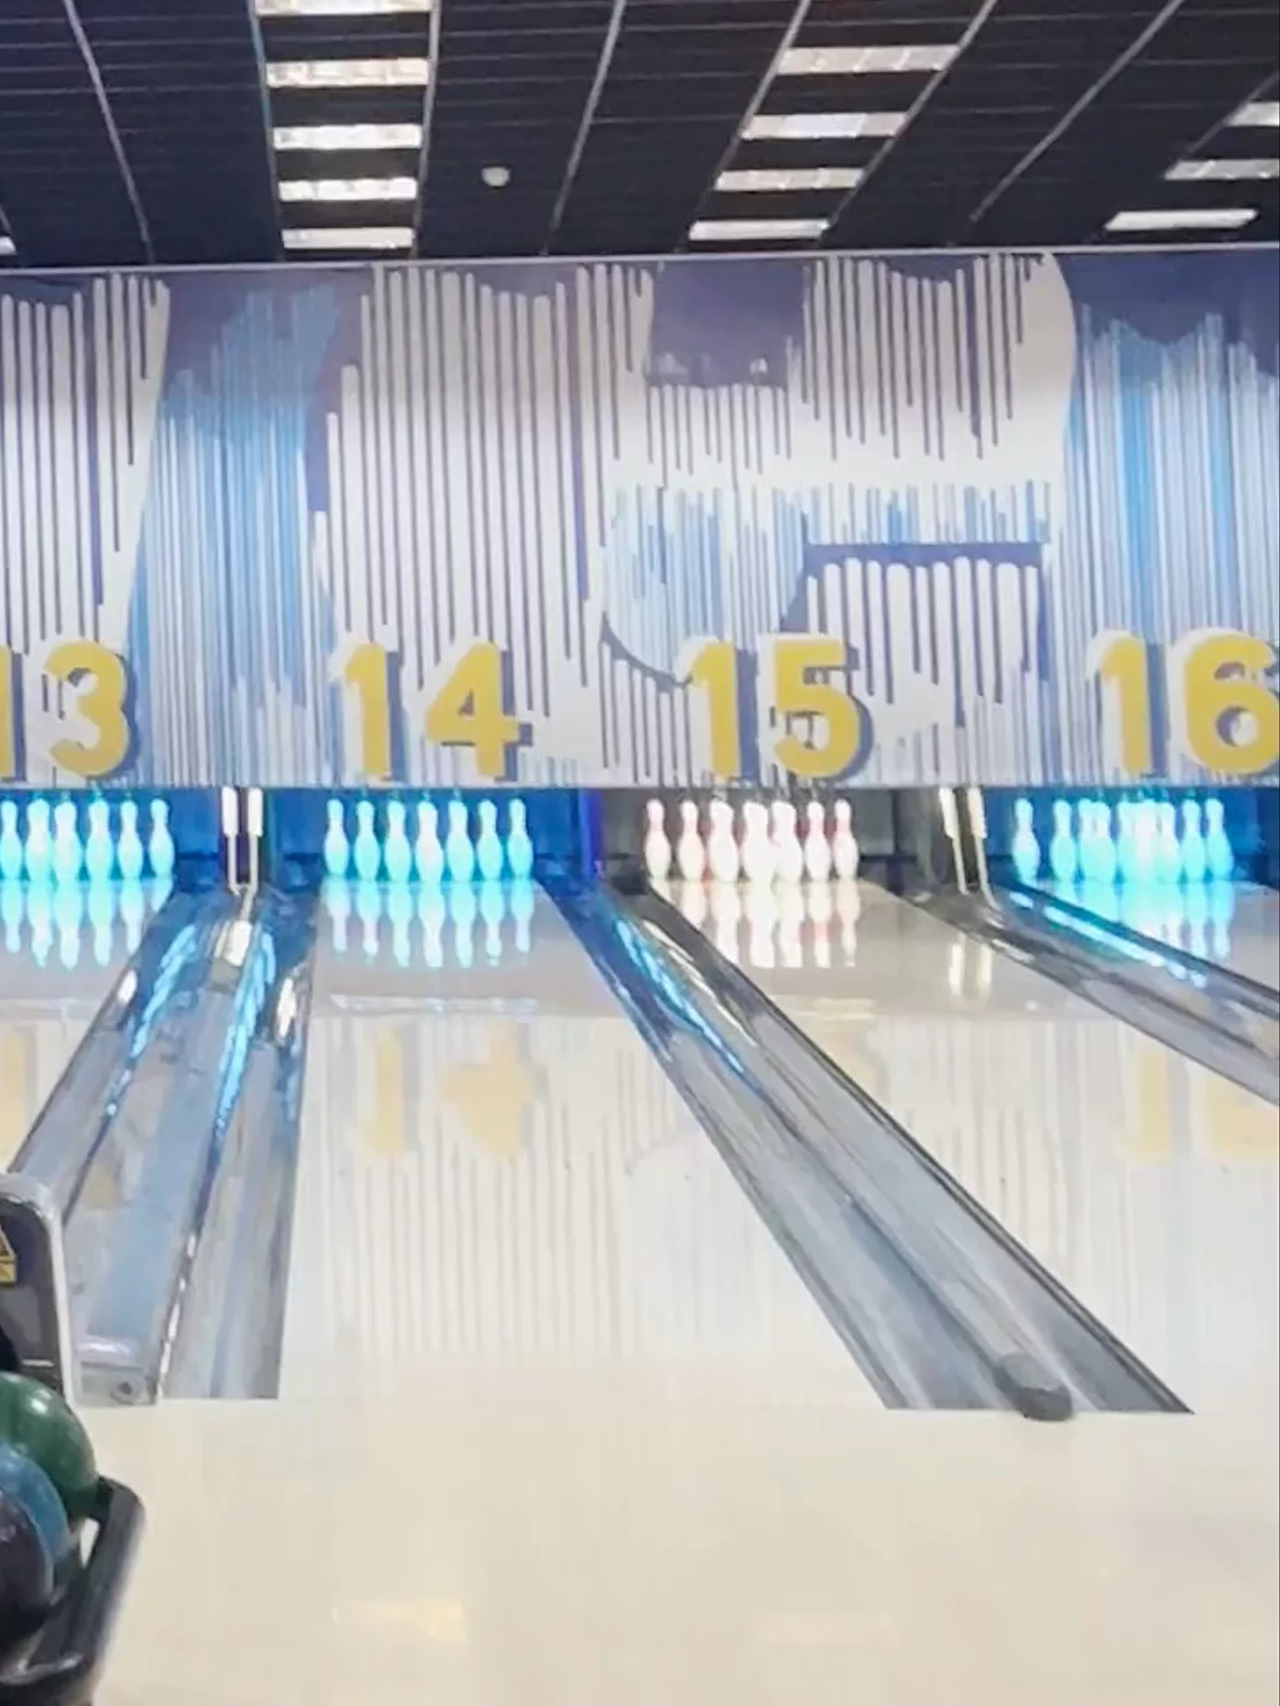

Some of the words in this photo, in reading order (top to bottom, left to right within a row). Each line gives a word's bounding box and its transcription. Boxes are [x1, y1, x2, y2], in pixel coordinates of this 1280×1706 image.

[346, 641, 520, 778] 14
[690, 639, 861, 778] 15
[1100, 633, 1280, 776] 16
